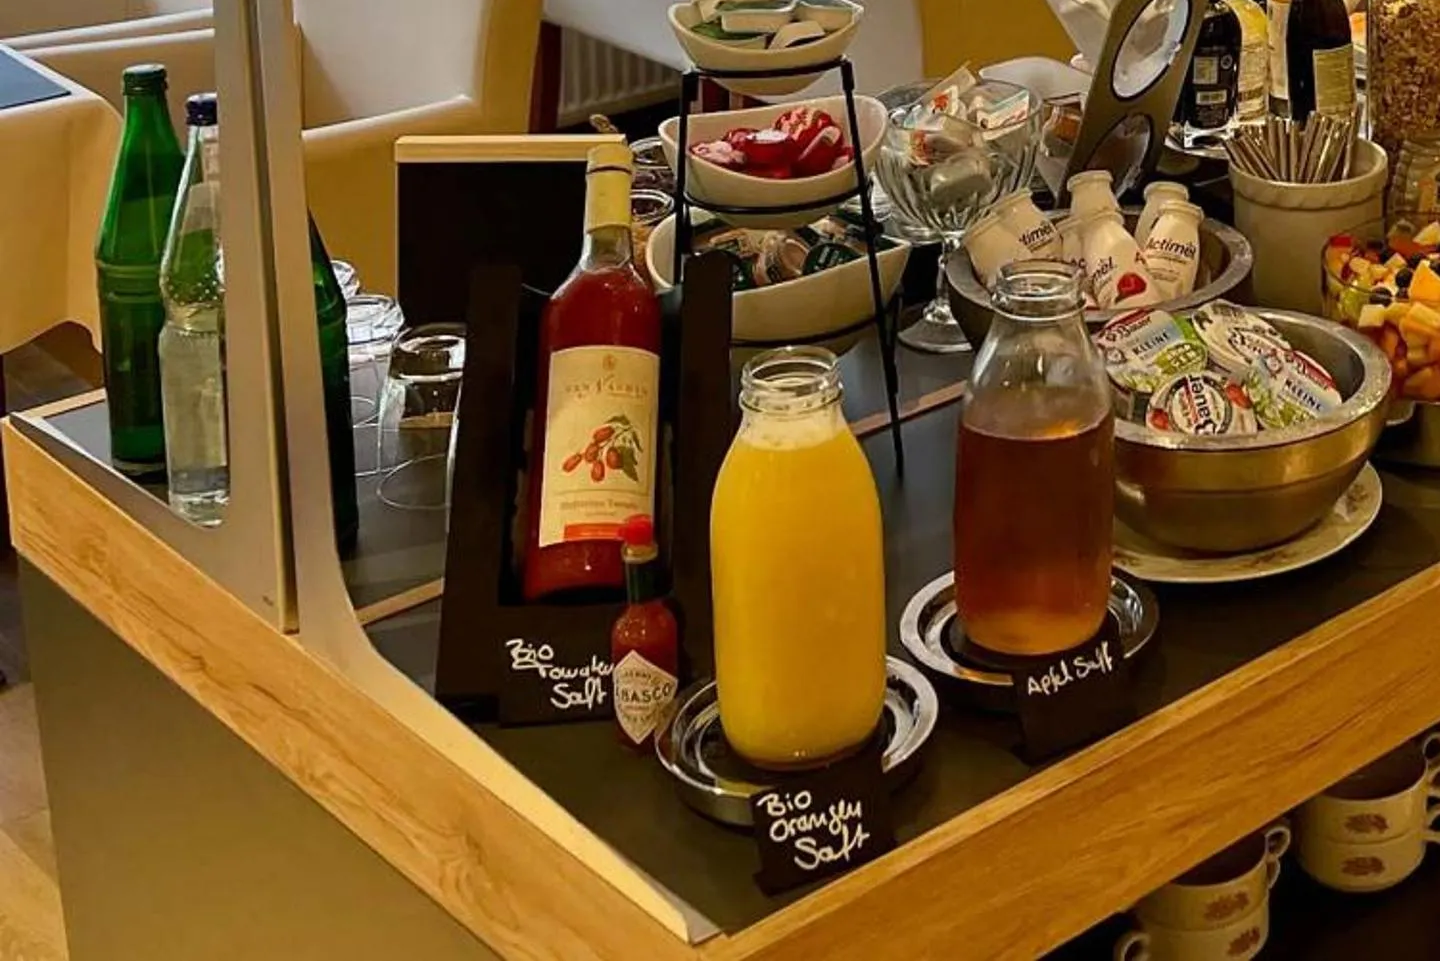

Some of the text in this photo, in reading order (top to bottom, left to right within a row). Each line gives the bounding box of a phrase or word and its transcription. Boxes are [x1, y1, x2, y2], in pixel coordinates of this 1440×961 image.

[505, 638, 554, 669] Bio
[550, 676, 608, 711] Saft
[617, 682, 672, 703] BASCO
[756, 790, 812, 817] Bio
[793, 822, 871, 871] Saft
